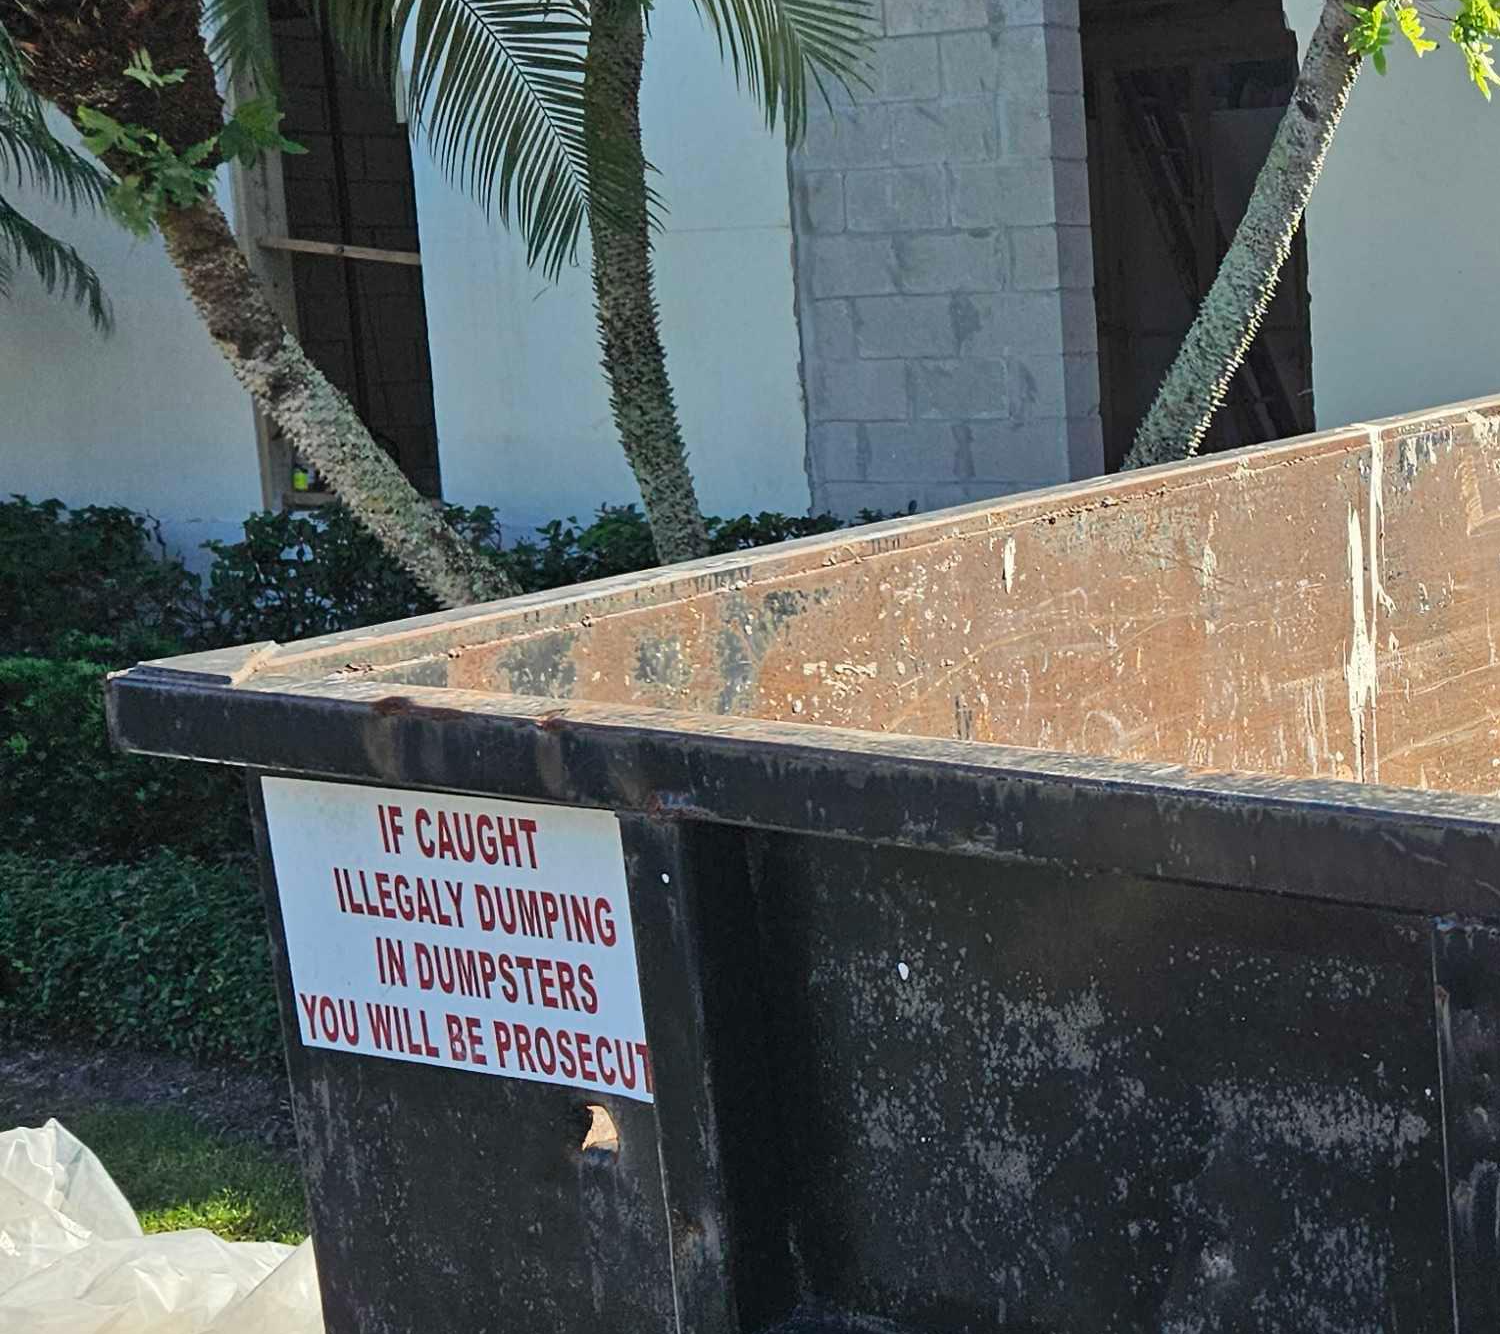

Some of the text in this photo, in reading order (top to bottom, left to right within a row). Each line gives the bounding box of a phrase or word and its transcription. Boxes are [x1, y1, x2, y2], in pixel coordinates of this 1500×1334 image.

[377, 804, 539, 869] IF CAUGHT
[333, 867, 617, 947] ILLEGALY DUMPING
[375, 936, 598, 1015] IN DUMPSTERS
[300, 992, 359, 1046] YOU
[366, 1002, 440, 1058] WILL
[445, 1013, 488, 1066] BE
